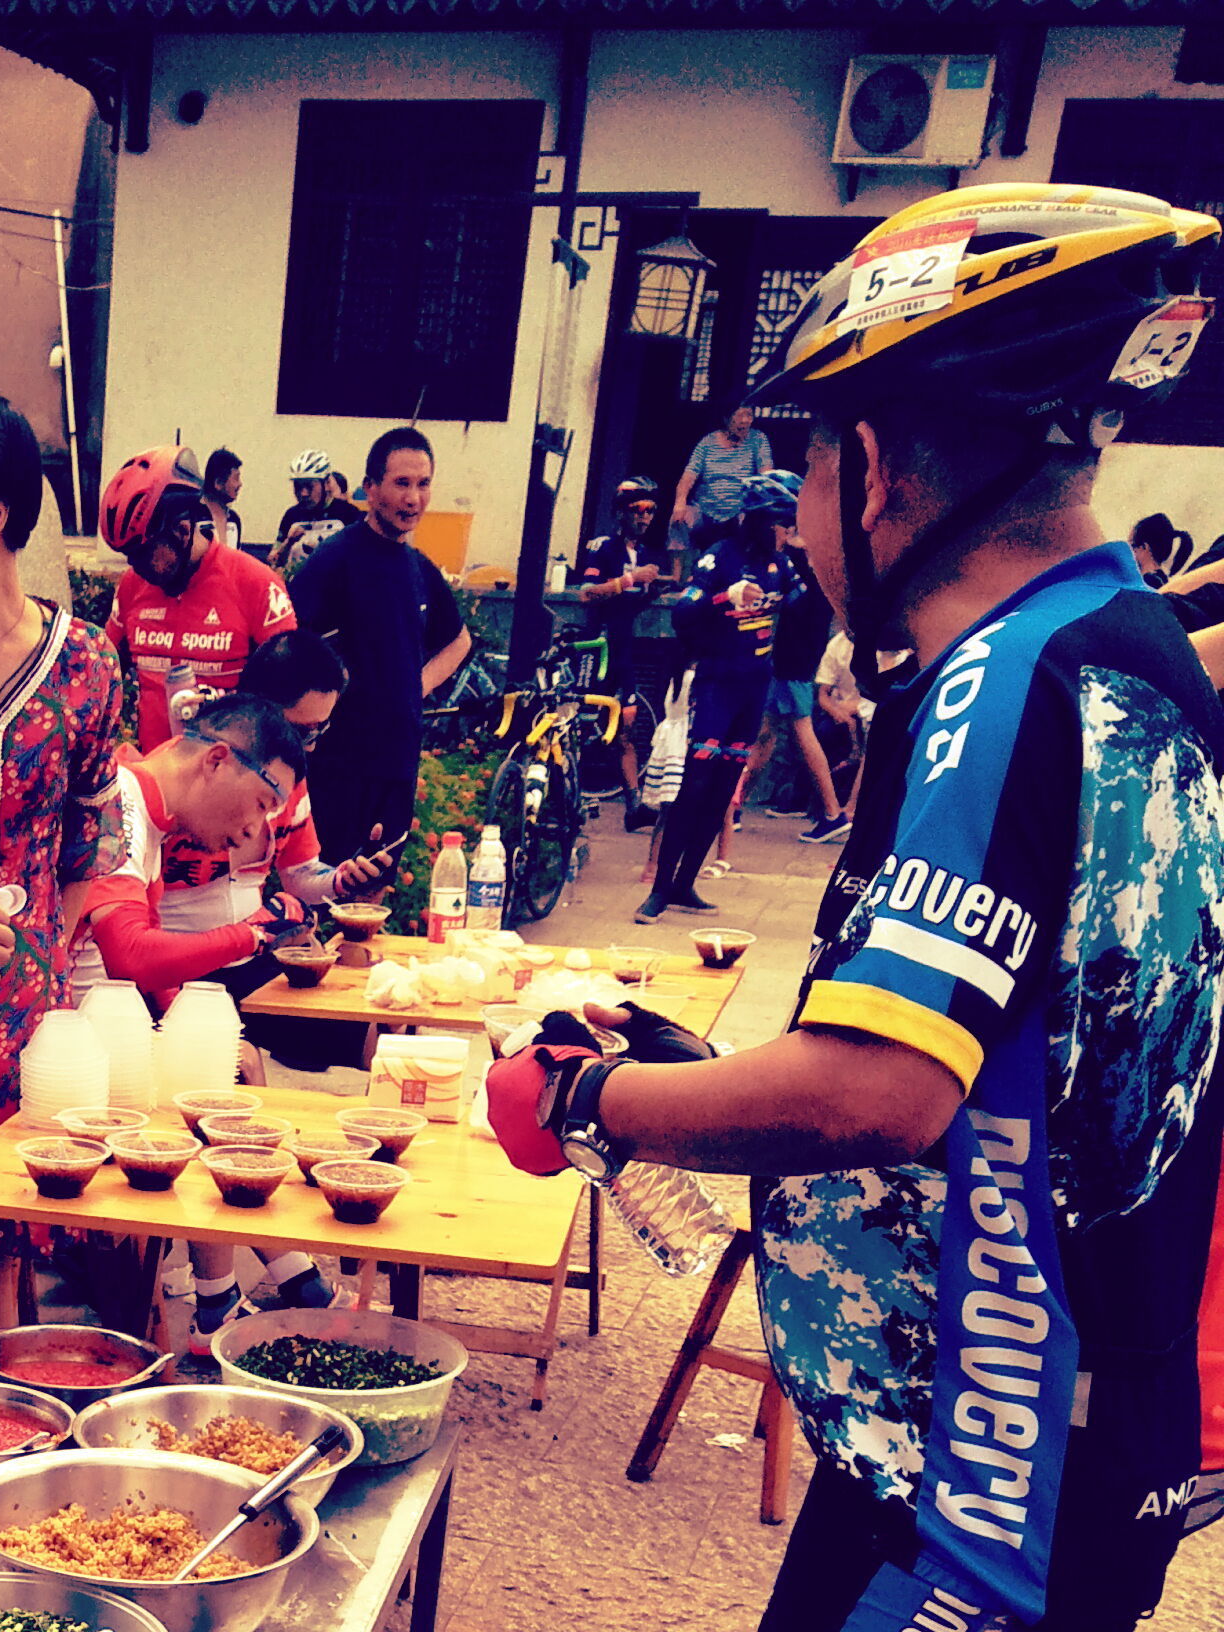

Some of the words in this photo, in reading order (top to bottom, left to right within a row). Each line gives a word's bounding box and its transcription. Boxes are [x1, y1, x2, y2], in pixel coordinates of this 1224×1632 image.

[865, 256, 940, 302] 5-2
[134, 626, 147, 645] le
[148, 631, 174, 649] coq
[181, 631, 233, 652] sportif
